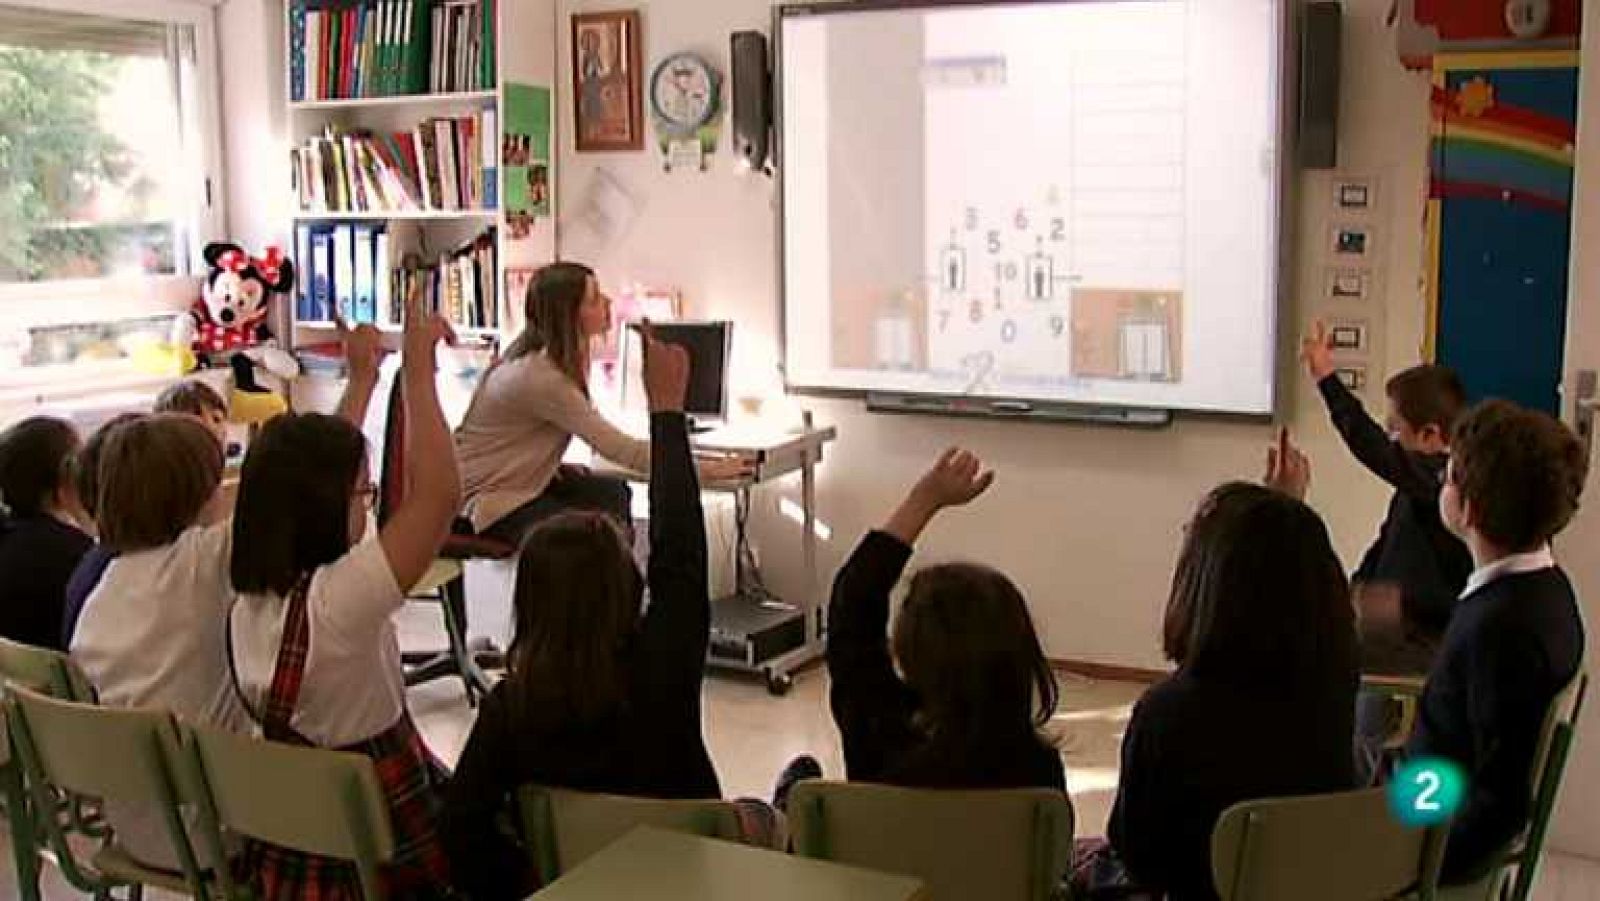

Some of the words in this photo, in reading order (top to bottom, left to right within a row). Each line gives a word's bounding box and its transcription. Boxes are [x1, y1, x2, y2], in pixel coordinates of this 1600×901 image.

[1050, 218, 1066, 240] 2
[987, 230, 1001, 253] 5
[1050, 316, 1064, 337] 9
